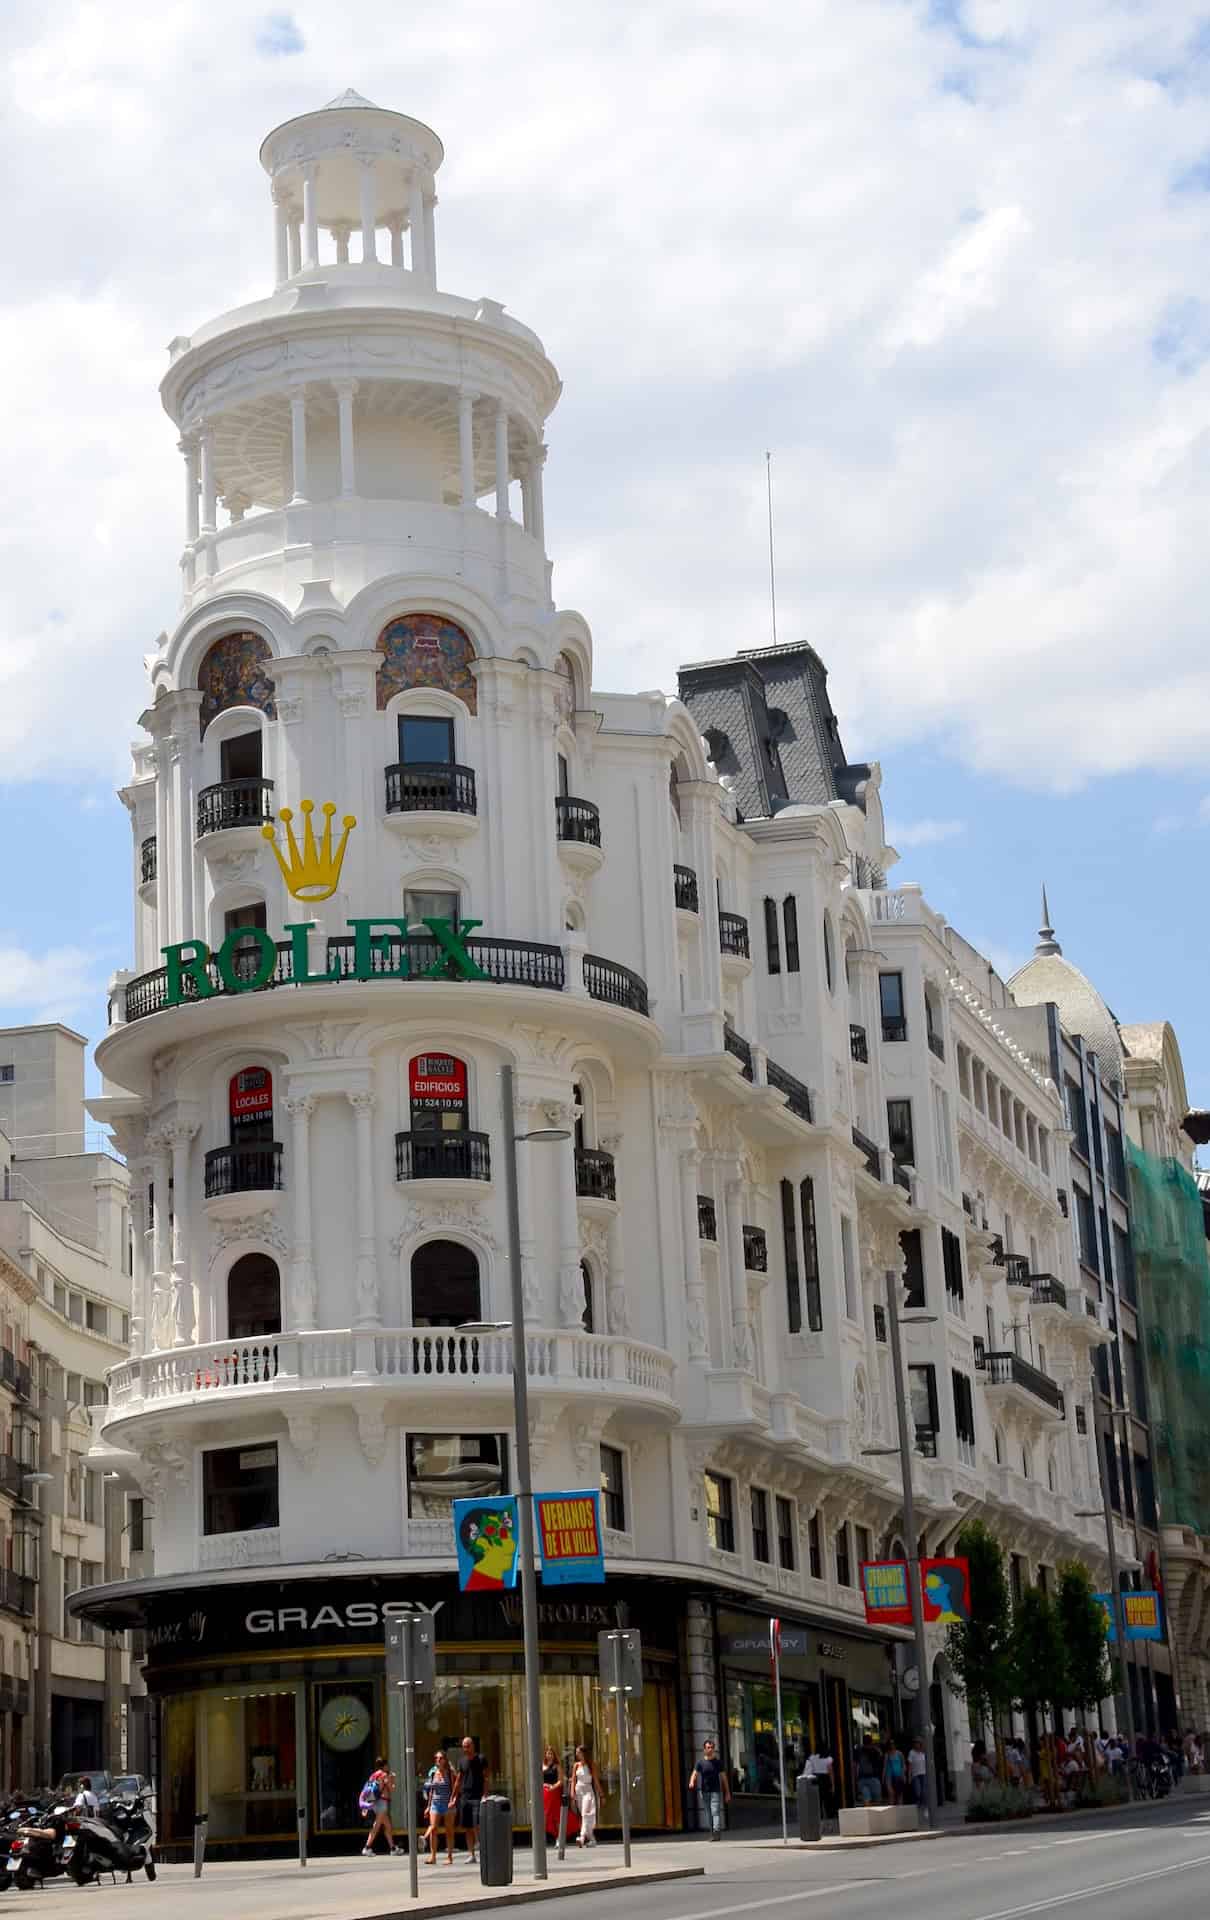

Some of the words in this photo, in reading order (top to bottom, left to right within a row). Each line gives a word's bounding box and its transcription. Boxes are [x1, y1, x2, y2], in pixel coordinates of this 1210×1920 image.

[160, 918, 487, 1006] ROLEX
[414, 1081, 461, 1093] EDIFICIOS
[235, 1094, 270, 1109] LOCALES
[424, 1098, 440, 1107] 524
[442, 1099, 452, 1108] 10
[541, 1500, 594, 1531] VERANOS
[545, 1532, 559, 1557] DE
[559, 1530, 573, 1556] LA
[572, 1530, 599, 1554] VILLA
[538, 1603, 610, 1624] ROLEX
